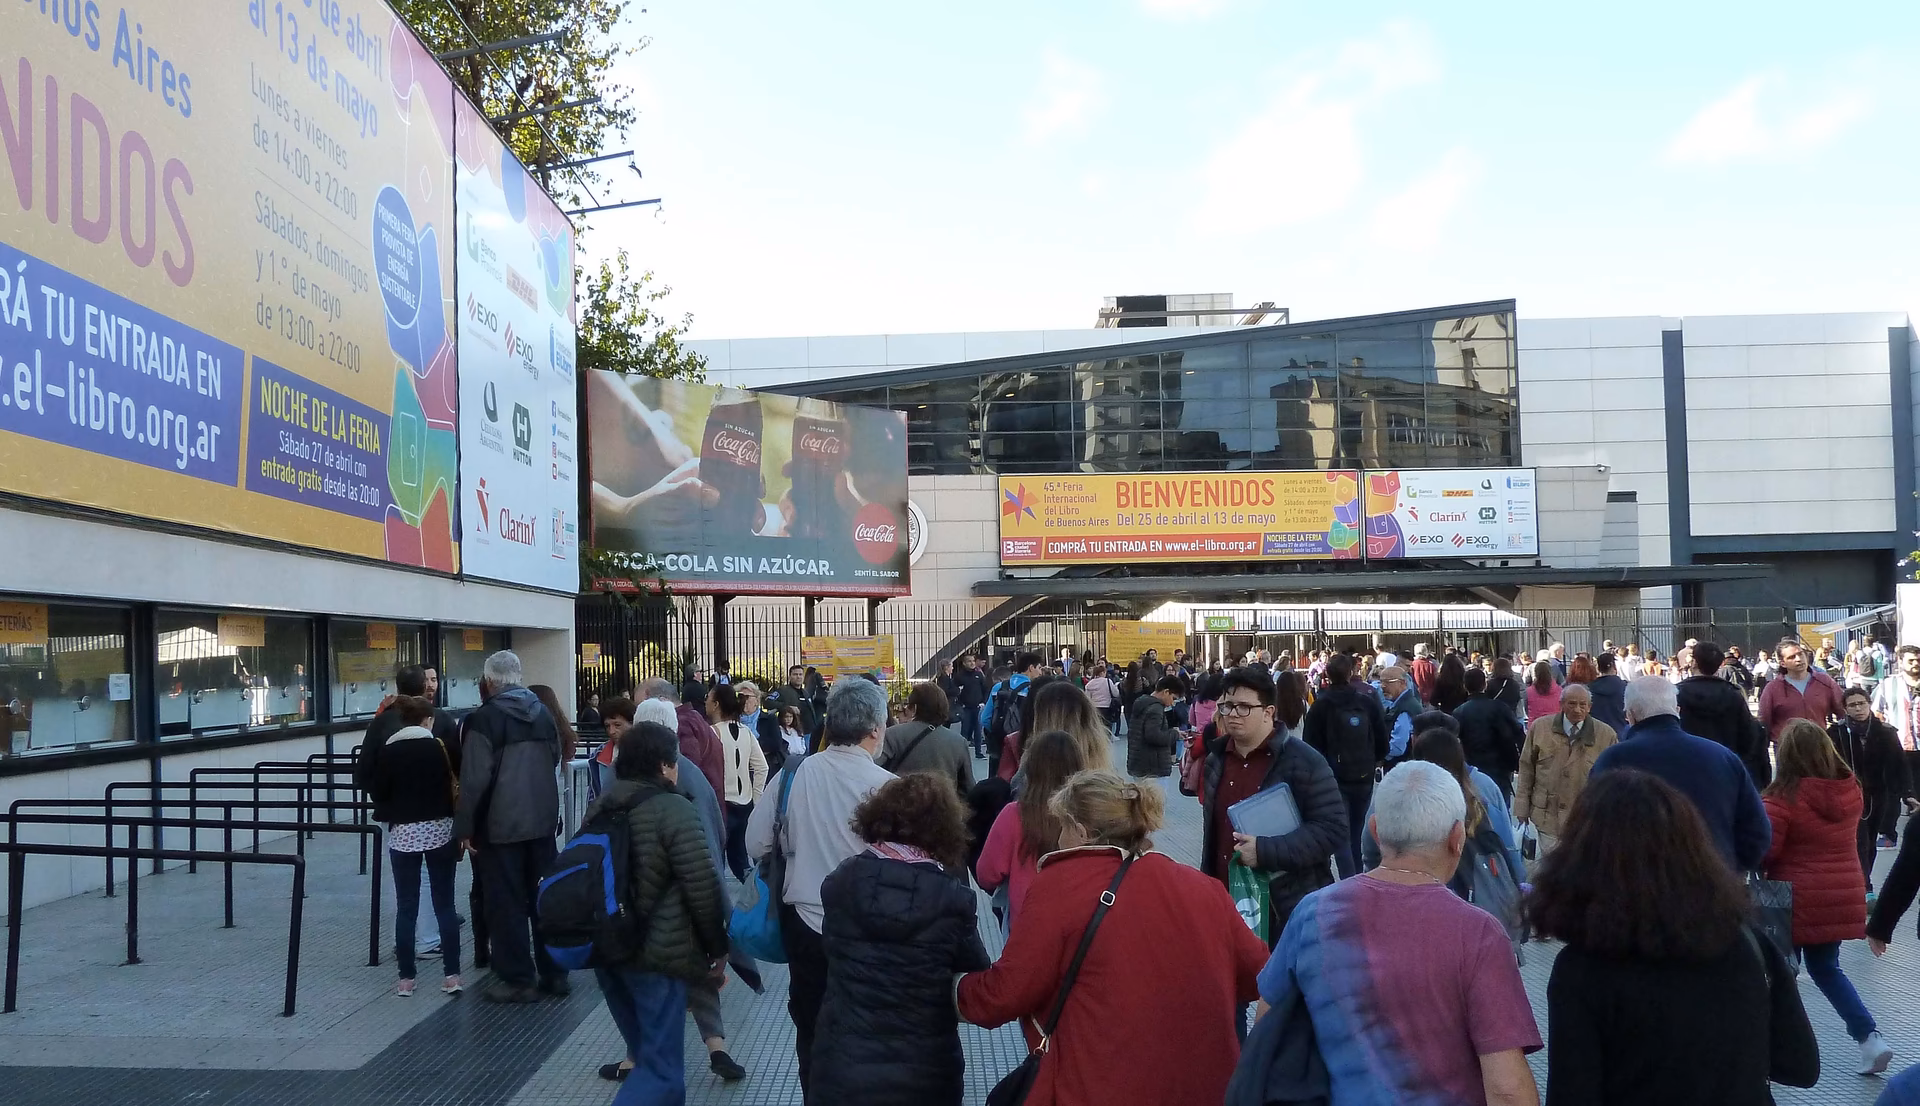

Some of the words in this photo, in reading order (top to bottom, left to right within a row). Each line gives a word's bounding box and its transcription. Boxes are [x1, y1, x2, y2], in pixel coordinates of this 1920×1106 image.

[346, 13, 382, 82] abril
[112, 8, 192, 118] Aires
[248, 0, 268, 37] al
[275, 1, 299, 64] 13
[307, 33, 328, 92] de
[335, 70, 378, 138] mayo
[250, 62, 290, 122] Lunes
[294, 108, 301, 132] a
[304, 117, 347, 170] viernes
[253, 114, 269, 154] de
[274, 131, 311, 185] 14:00
[314, 171, 321, 194] a
[325, 172, 357, 220] 22:00
[378, 202, 401, 236] PRIMERA
[401, 225, 416, 248] FERIA
[255, 190, 313, 260] Sábados,
[316, 233, 369, 293] domingos
[381, 227, 407, 260] PROVISTA
[406, 248, 414, 267] DE
[481, 238, 496, 262] Banco
[388, 253, 410, 284] ENERGÍA
[256, 249, 263, 283] y
[292, 264, 307, 299] de
[311, 282, 341, 323] mayo
[381, 271, 416, 310] SUSTENTABLE
[477, 301, 498, 333] EXO
[41, 284, 75, 346] TU
[85, 303, 191, 389] ENTRADA
[197, 350, 221, 400] EN
[256, 294, 273, 330] de
[278, 304, 314, 351] 13:00
[318, 334, 325, 356] a
[329, 331, 360, 373] 22:00
[515, 336, 533, 363] EXO
[523, 359, 539, 381] energy
[0, 348, 221, 469] .el-libro.org.ar
[261, 376, 308, 429] NOCHE
[311, 397, 328, 436] DE
[332, 405, 346, 443] LA
[350, 413, 381, 456] FERIA
[279, 430, 309, 460] Sábado
[312, 441, 322, 463] 27
[324, 446, 333, 468] de
[336, 453, 352, 474] abril
[354, 461, 367, 478] con
[512, 448, 532, 467] HUTTON
[261, 456, 295, 485] entrada
[298, 467, 322, 493] gratis
[324, 473, 345, 499] desde
[348, 479, 358, 501] las
[359, 483, 380, 507] 20:00
[1063, 481, 1083, 491] Feria
[1116, 479, 1275, 508] BIENVENIDOS
[1044, 493, 1097, 504] Internacional
[1044, 506, 1057, 515] del
[1059, 505, 1080, 515] Libro
[499, 508, 531, 545] Clarín
[1044, 518, 1055, 527] de
[1057, 517, 1086, 527] Buenos
[1088, 517, 1109, 527] Aires
[1117, 513, 1134, 526] Del
[1138, 513, 1152, 526] 25
[1156, 513, 1169, 525] de
[1172, 512, 1197, 525] abril
[1200, 512, 1210, 525] al
[1214, 512, 1227, 525] 13
[1231, 511, 1244, 524] de
[1248, 513, 1276, 527] mayo
[1430, 511, 1461, 522] Clarín
[1048, 538, 1087, 554] COMPRÁ
[1089, 541, 1100, 553] TU
[1104, 540, 1148, 553] ENTRADA
[1150, 540, 1162, 552] EN
[1164, 540, 1257, 553] www.el-libro.org.ar
[1267, 534, 1286, 542] NOCHE
[1288, 534, 1296, 542] DE
[1305, 533, 1322, 541] FERIA
[1420, 535, 1443, 543] EXO
[1466, 536, 1489, 544] EXO
[1476, 542, 1498, 550] energy
[599, 551, 718, 573] OCA-COLA
[723, 556, 753, 573] SIN
[758, 554, 834, 576] AZÚCAR.
[854, 568, 871, 577] SENTÍ
[880, 570, 900, 578] SABOR
[1210, 619, 1229, 628] SALIDA
